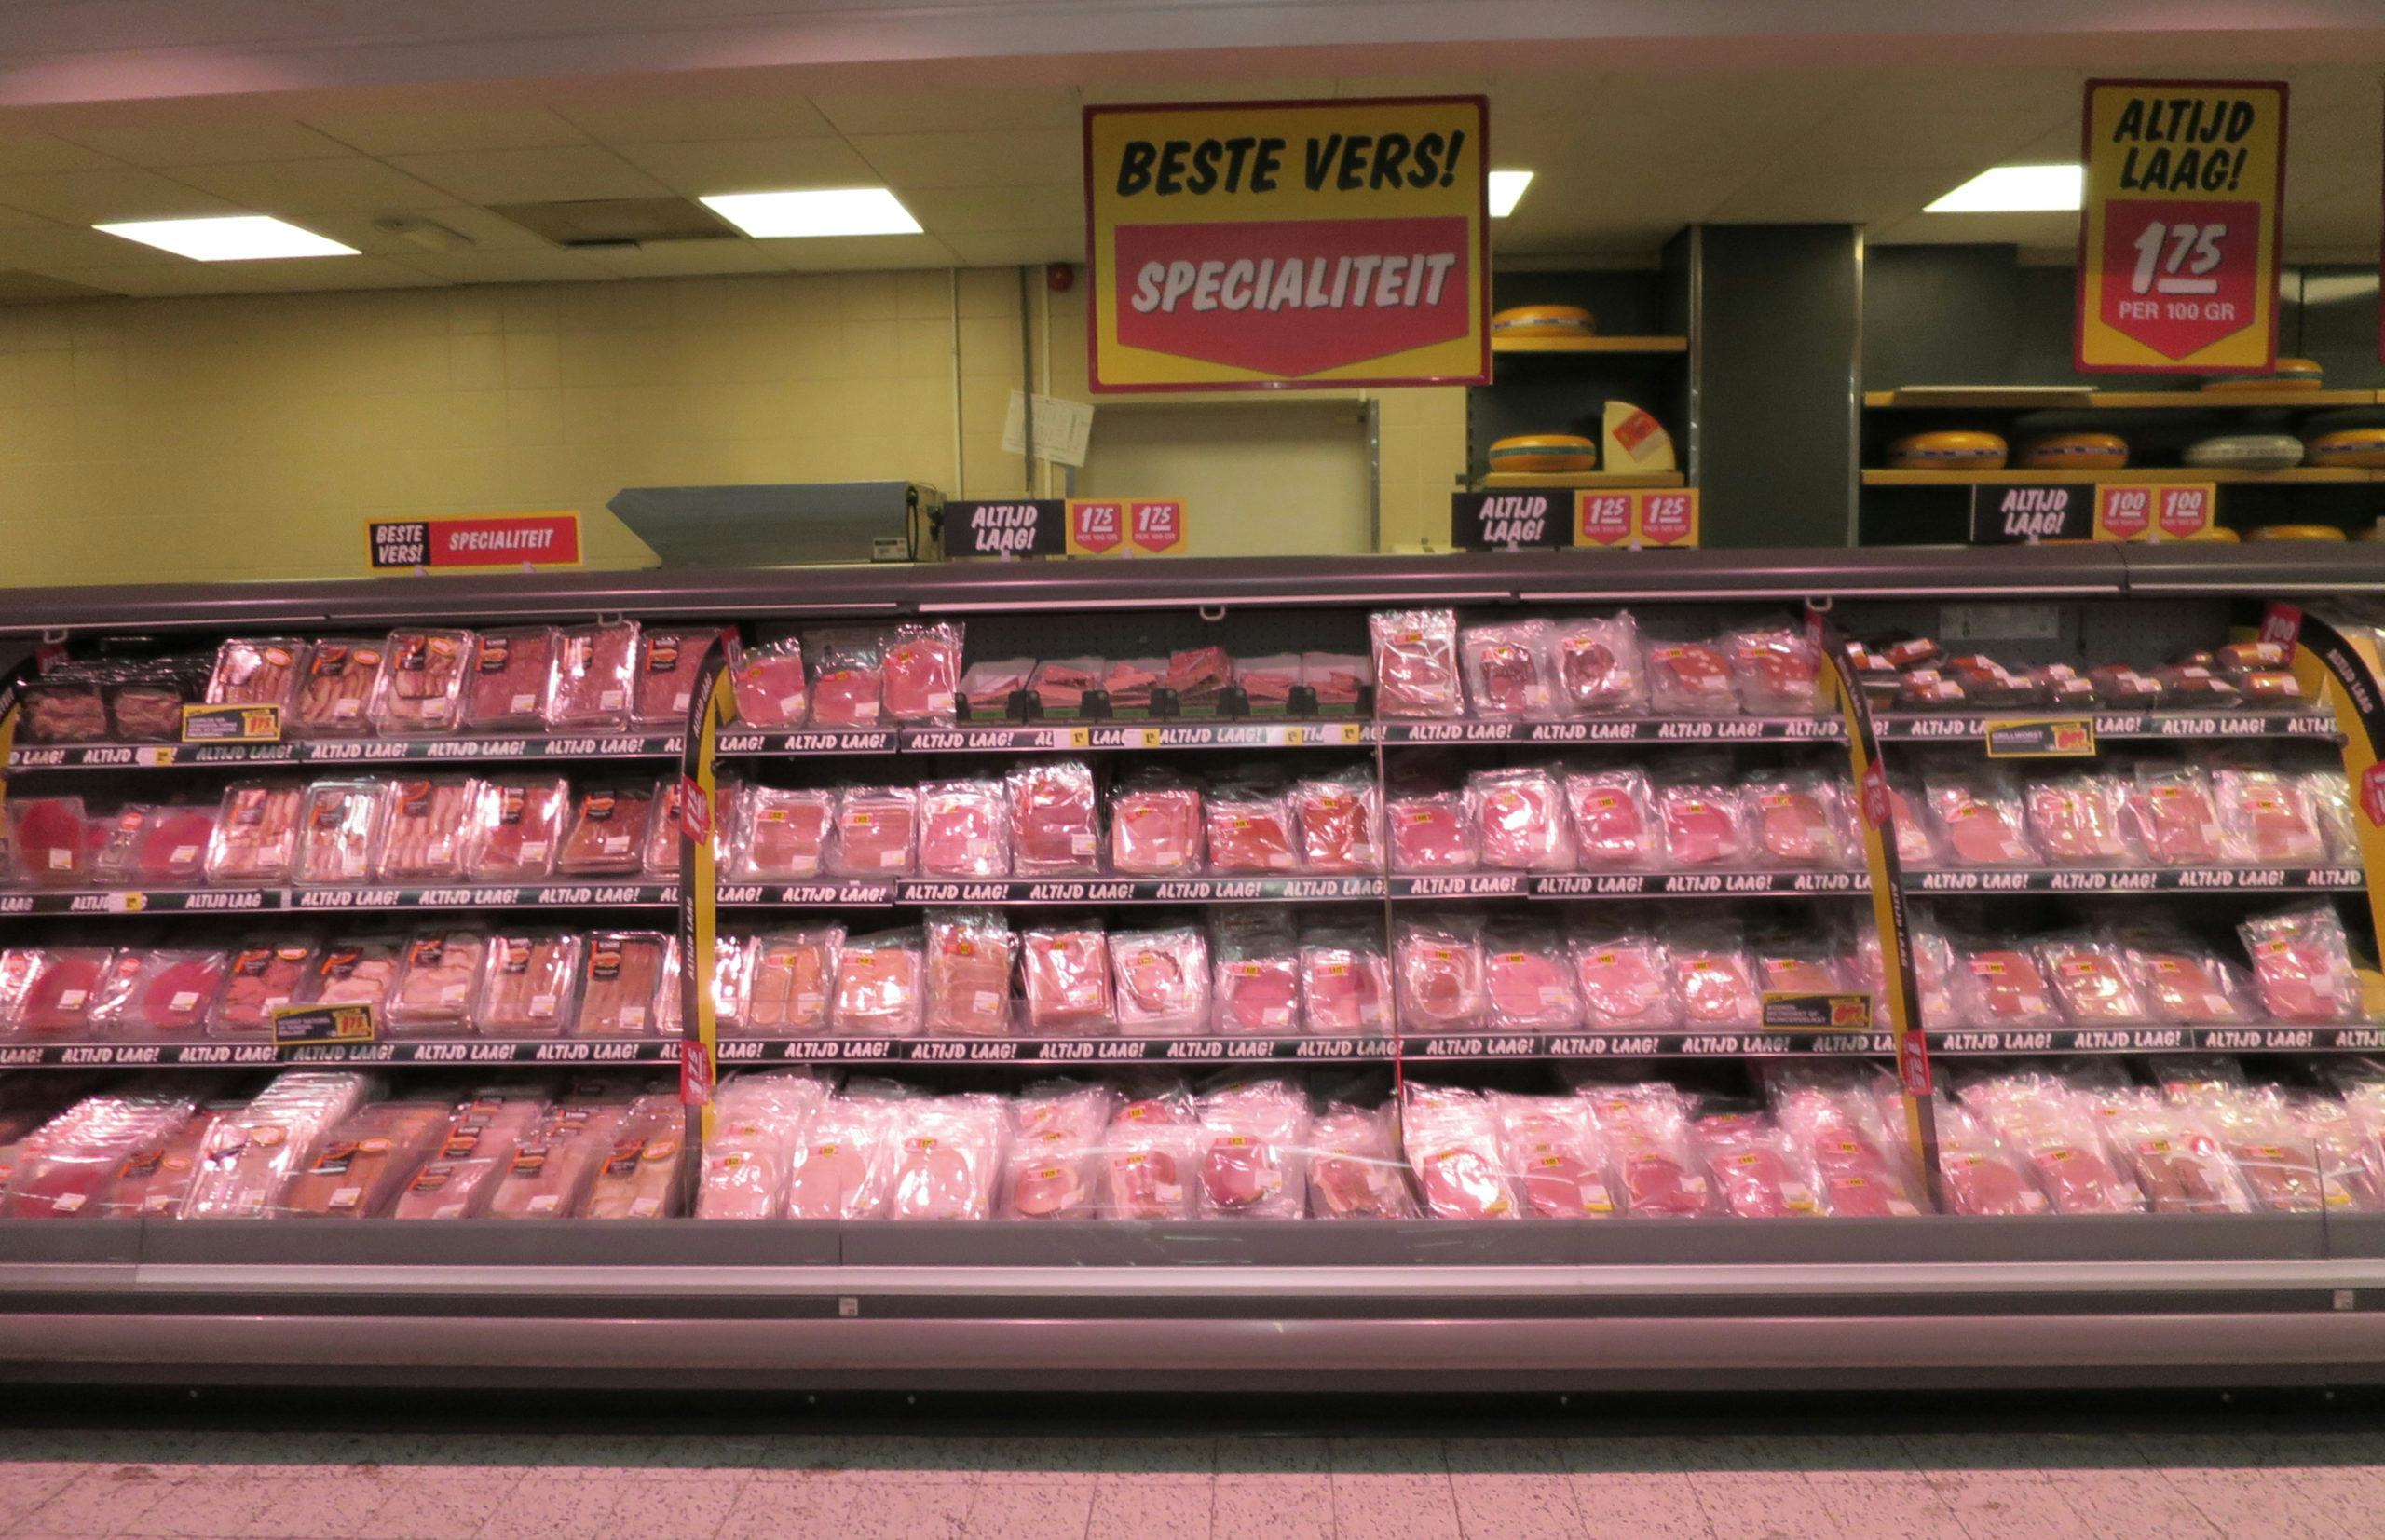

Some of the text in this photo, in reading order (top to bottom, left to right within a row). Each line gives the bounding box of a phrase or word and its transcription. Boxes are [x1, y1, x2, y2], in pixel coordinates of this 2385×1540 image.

[2112, 98, 2255, 143] ALTIJD
[1116, 129, 1465, 197] BESTE VERS!
[2119, 147, 2247, 192] LAAG!
[1131, 252, 1456, 314] SPECIALITEIT
[2119, 302, 2235, 320] PER 100 GR
[2001, 489, 2069, 511] ALTIJD
[1479, 497, 1547, 520] ALTIJD
[971, 505, 1038, 528] ALTIJD
[2005, 512, 2065, 535] LAAG!
[376, 525, 424, 543] BESTE
[1483, 519, 1545, 541] LAAG!
[449, 529, 553, 551] SPECIALITEIT
[975, 528, 1036, 551] LAAG!
[378, 544, 424, 563] VERS!
[1409, 725, 1513, 740] ALTIJD LAAG!
[1533, 723, 1637, 739] ALTIJD LAAG!
[1659, 723, 1764, 738] ALTIJD LAAG!
[1786, 722, 1839, 737] ALTIJD
[1911, 721, 1964, 735] ALTIJD
[2096, 719, 2141, 733] LAAG!
[2161, 718, 2266, 733] ALTIJD LAAG!
[784, 735, 886, 750] ALTIJD LAAG!
[912, 733, 1014, 748] ALTIJD LAAG!
[1217, 728, 1261, 743] LAAG!
[311, 742, 406, 757] ALTIJD LAAG!
[427, 741, 526, 756] ALTIJD LAAG!
[545, 739, 645, 754] ALTIJD LAAG!
[719, 736, 765, 751] LAAG!
[22, 749, 65, 764] LAAG!
[83, 748, 131, 763] ALTIJD
[1666, 876, 1772, 892] ALTIJD LAAG!
[1794, 875, 1850, 890] ALTIJD
[1923, 873, 2028, 888] ALTIJD LAAG!
[2051, 873, 2157, 888] ALTIJD LAAG!
[2179, 870, 2284, 885] ALTIJD LAAG!
[2307, 870, 2362, 885] ALTIJD
[905, 884, 1009, 899] ALTIJD LAAG!
[1029, 883, 1134, 899] ALTIJD LAAG!
[1157, 882, 1261, 898] ALTIJD LAAG!
[1283, 881, 1337, 895] ALTIJD
[1411, 878, 1517, 893] ALTIJD LAAG!
[1537, 878, 1643, 893] ALTIJD LAAG!
[185, 894, 227, 909] ALTIJD
[301, 891, 399, 906] ALTIJD LAAG!
[419, 889, 520, 904] ALTIJD LAAG!
[539, 888, 640, 902] ALTIJD LAAG!
[717, 887, 762, 901] LAAG!
[783, 888, 886, 902] ALTIJD LAAG!
[1426, 1039, 1534, 1055] ALTIJD LAAG!
[1550, 1038, 1658, 1054] ALTIJD LAAG!
[1682, 1038, 1737, 1053] ALTIJD
[1812, 1037, 1868, 1052] ALTIJD
[1943, 1033, 2051, 1049] ALTIJD LAAG!
[2075, 1032, 2182, 1047] ALTIJD LAAG!
[2206, 1032, 2312, 1047] ALTIJD LAAG!
[1, 1049, 43, 1063] LAAG!
[61, 1047, 159, 1062] ALTIJD LAAG!
[179, 1046, 278, 1061] ALTIJD LAAG!
[293, 1044, 394, 1060] ALTIJD LAAG!
[414, 1044, 515, 1059] ALTIJD LAAG!
[536, 1044, 638, 1059] ALTIJD LAAG!
[718, 1044, 763, 1058] LAAG!
[784, 1042, 890, 1057] ALTIJD LAAG!
[911, 1043, 1017, 1058] ALTIJD LAAG!
[1039, 1043, 1145, 1057] ALTIJD LAAG!
[1167, 1042, 1274, 1056] ALTIJD LAAG!
[1297, 1041, 1352, 1056] ALTIJD
